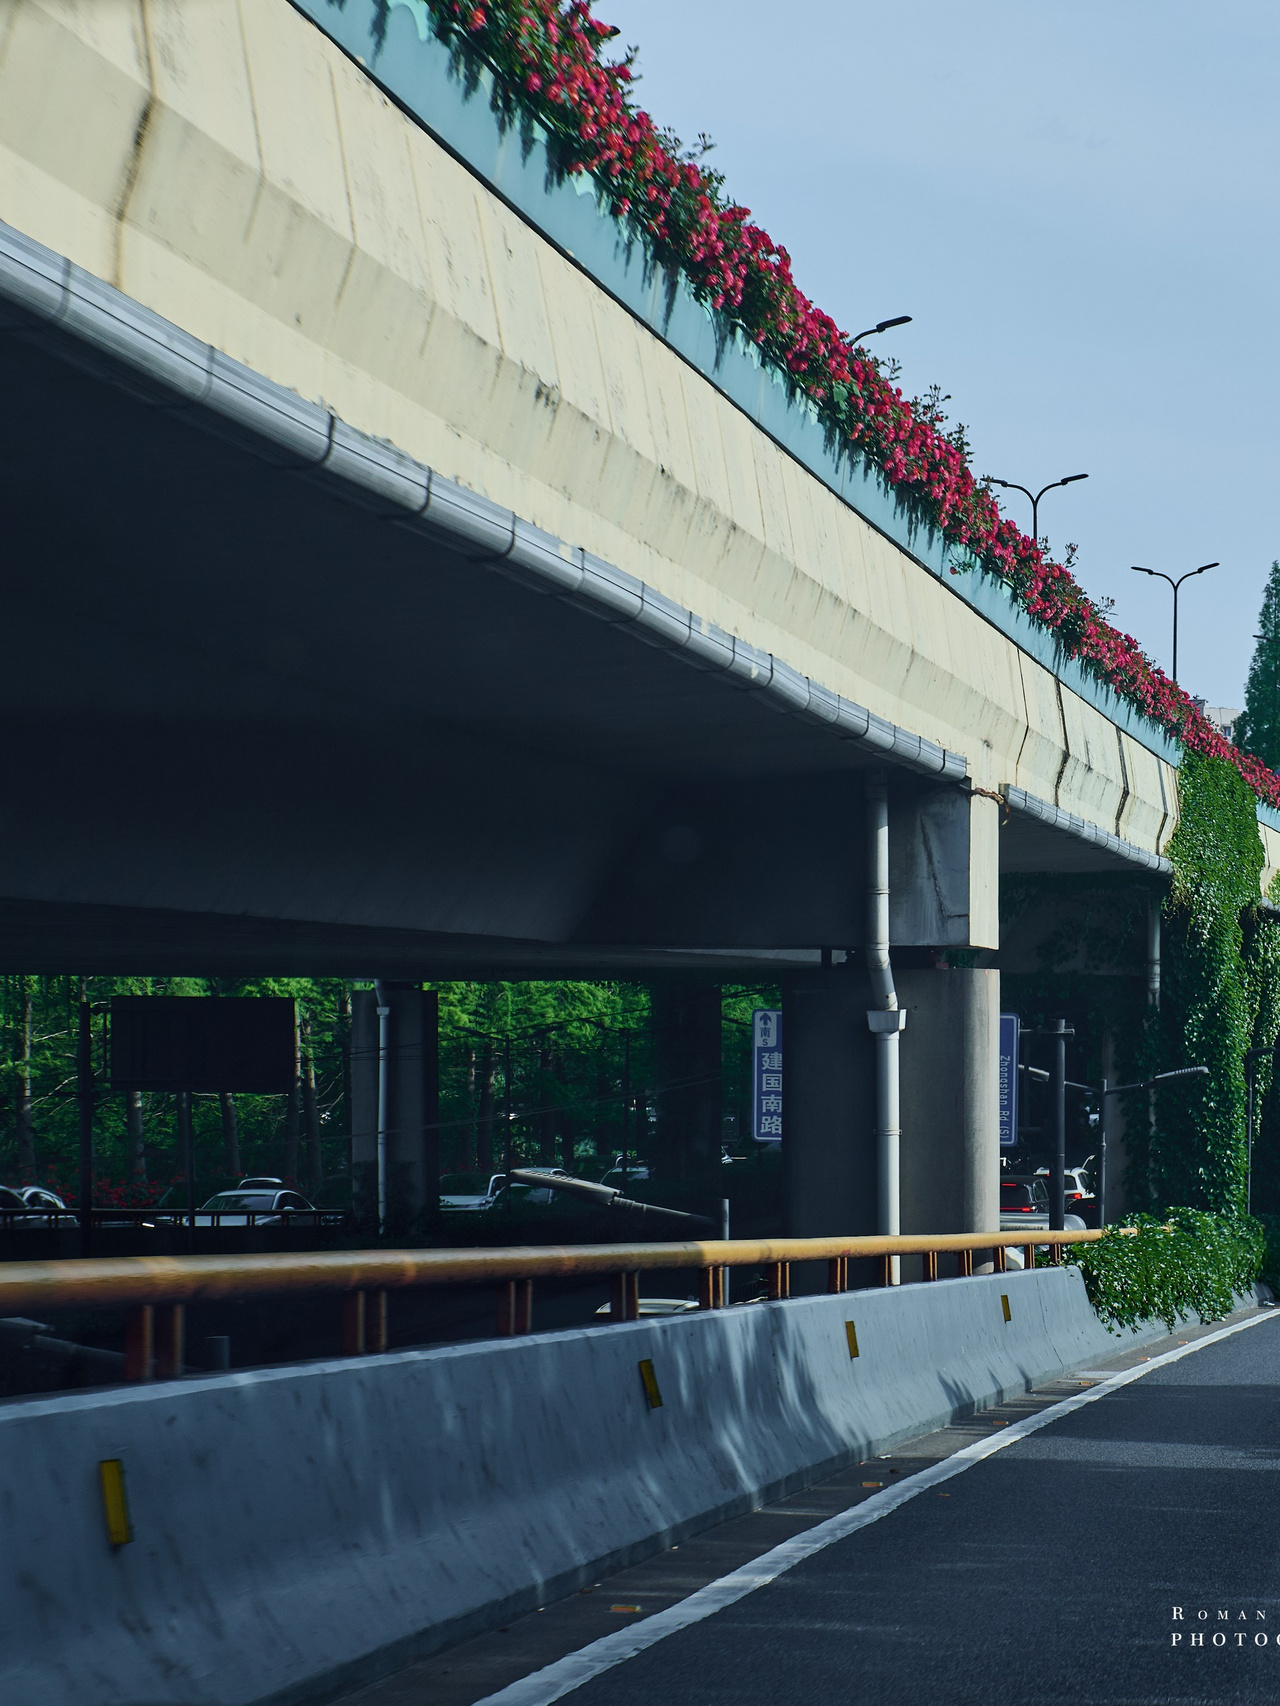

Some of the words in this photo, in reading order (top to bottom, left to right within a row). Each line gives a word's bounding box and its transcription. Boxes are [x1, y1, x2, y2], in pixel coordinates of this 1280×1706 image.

[760, 1026, 771, 1038] 南
[762, 1038, 769, 1046] S
[1000, 1055, 1010, 1105] Zhongshan
[760, 1051, 782, 1135] 建国南路
[1000, 1110, 1010, 1121] Rd
[1000, 1125, 1010, 1139] (S)
